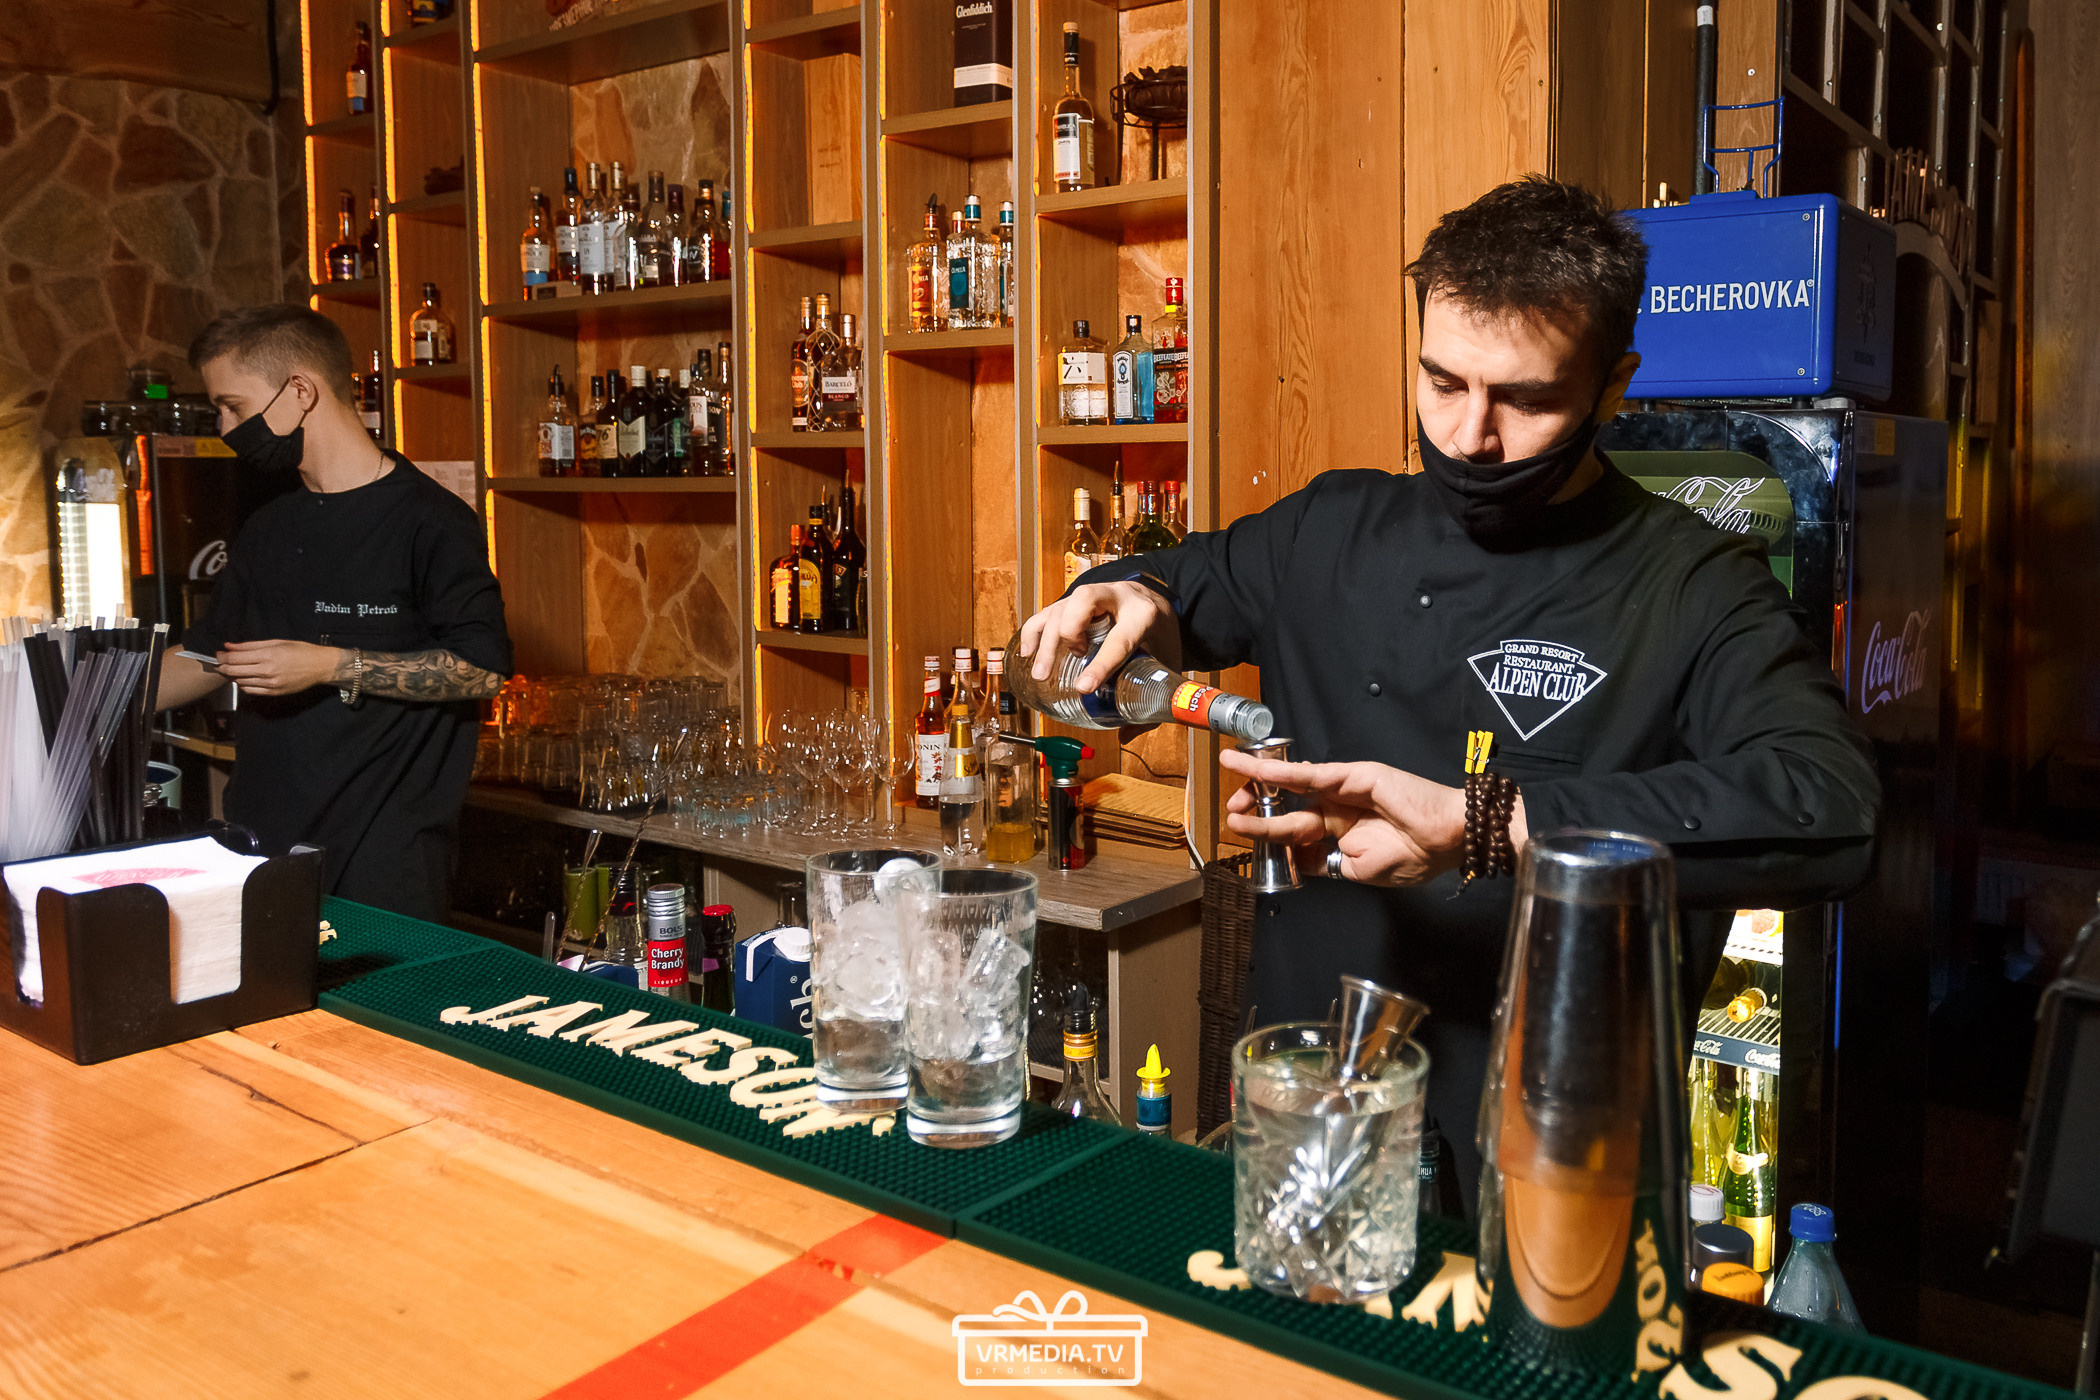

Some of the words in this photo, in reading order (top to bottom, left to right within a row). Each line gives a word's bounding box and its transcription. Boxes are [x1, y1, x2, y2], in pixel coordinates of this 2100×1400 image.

[956, 1, 993, 18] Glenfiddich
[1504, 643, 1539, 655] GRAND
[1541, 646, 1579, 663] RESORT
[1503, 654, 1576, 674] RESTAURANT
[1486, 662, 1543, 697] ALPEN
[1543, 672, 1588, 702] CLUB
[919, 743, 941, 751] ONIN
[659, 925, 683, 935] BOLS
[651, 947, 684, 959] Cherry
[651, 958, 685, 970] Brandy
